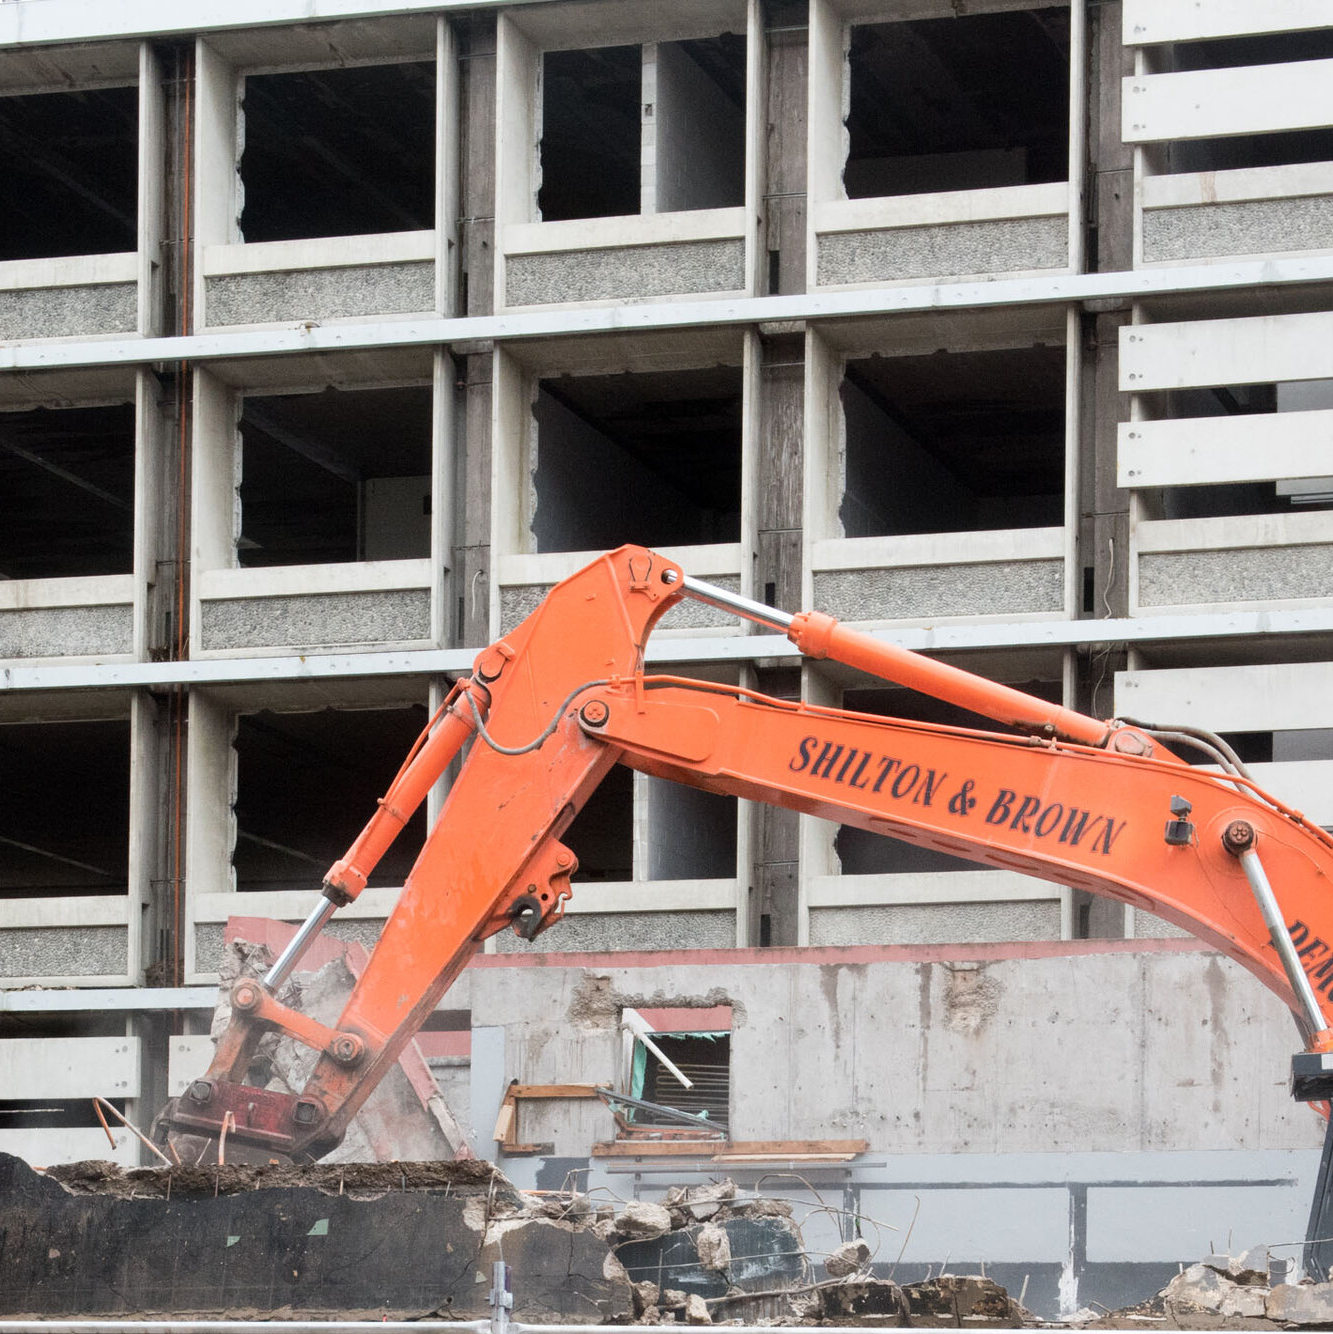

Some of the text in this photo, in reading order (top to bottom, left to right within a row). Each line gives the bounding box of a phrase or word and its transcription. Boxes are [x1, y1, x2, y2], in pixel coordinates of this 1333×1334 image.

[789, 736, 1127, 855] SHILTON & BROWN
